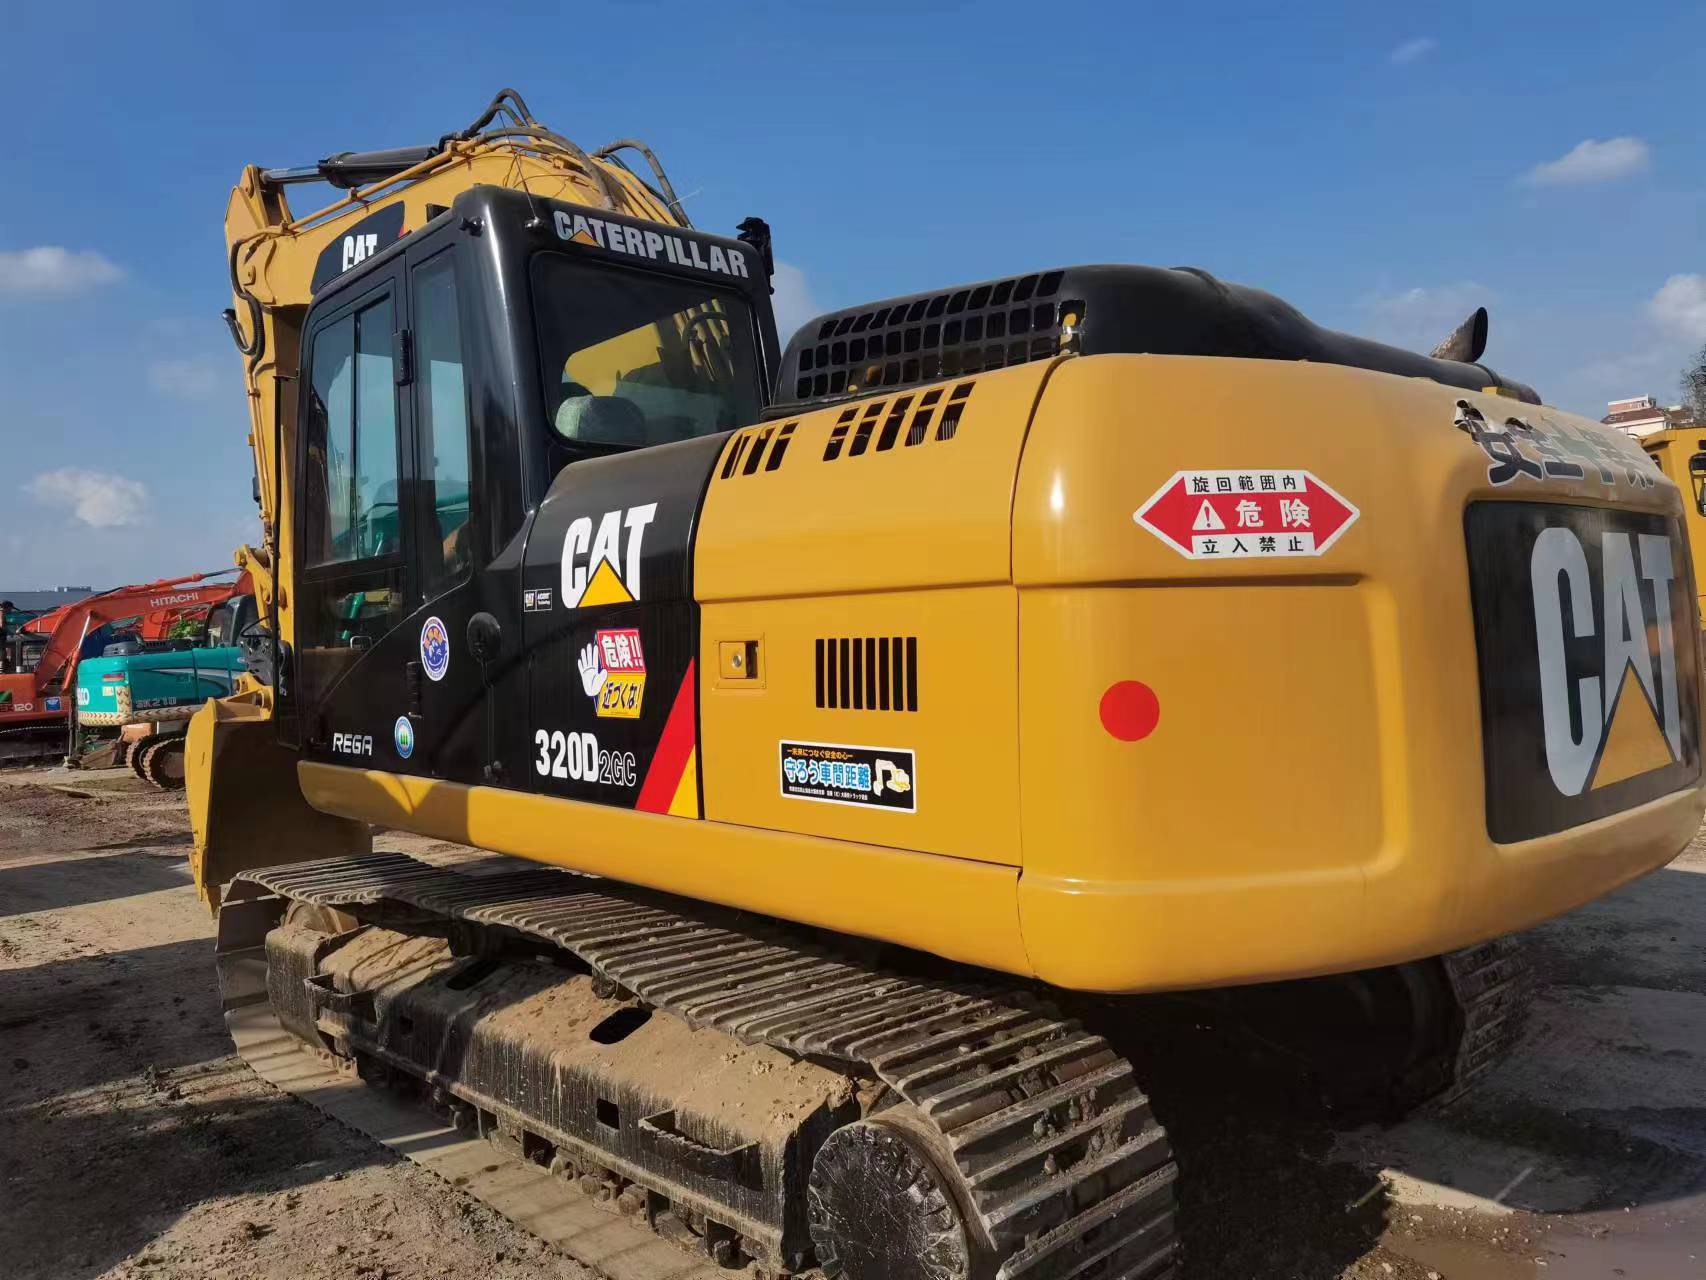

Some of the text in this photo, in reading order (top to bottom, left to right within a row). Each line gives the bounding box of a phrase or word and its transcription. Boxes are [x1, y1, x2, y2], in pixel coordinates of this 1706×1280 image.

[342, 233, 378, 273] CAT
[553, 210, 749, 279] CATERPILLAR
[1192, 474, 1297, 493] 旋回範囲内
[1234, 497, 1312, 529] 危険
[561, 502, 658, 609] CAT
[1201, 535, 1305, 554] 立入禁止
[150, 592, 200, 608] HITACHI
[1531, 527, 1682, 796] CAT
[332, 732, 373, 757] REGA
[784, 757, 871, 791] 守ろう車間距離
